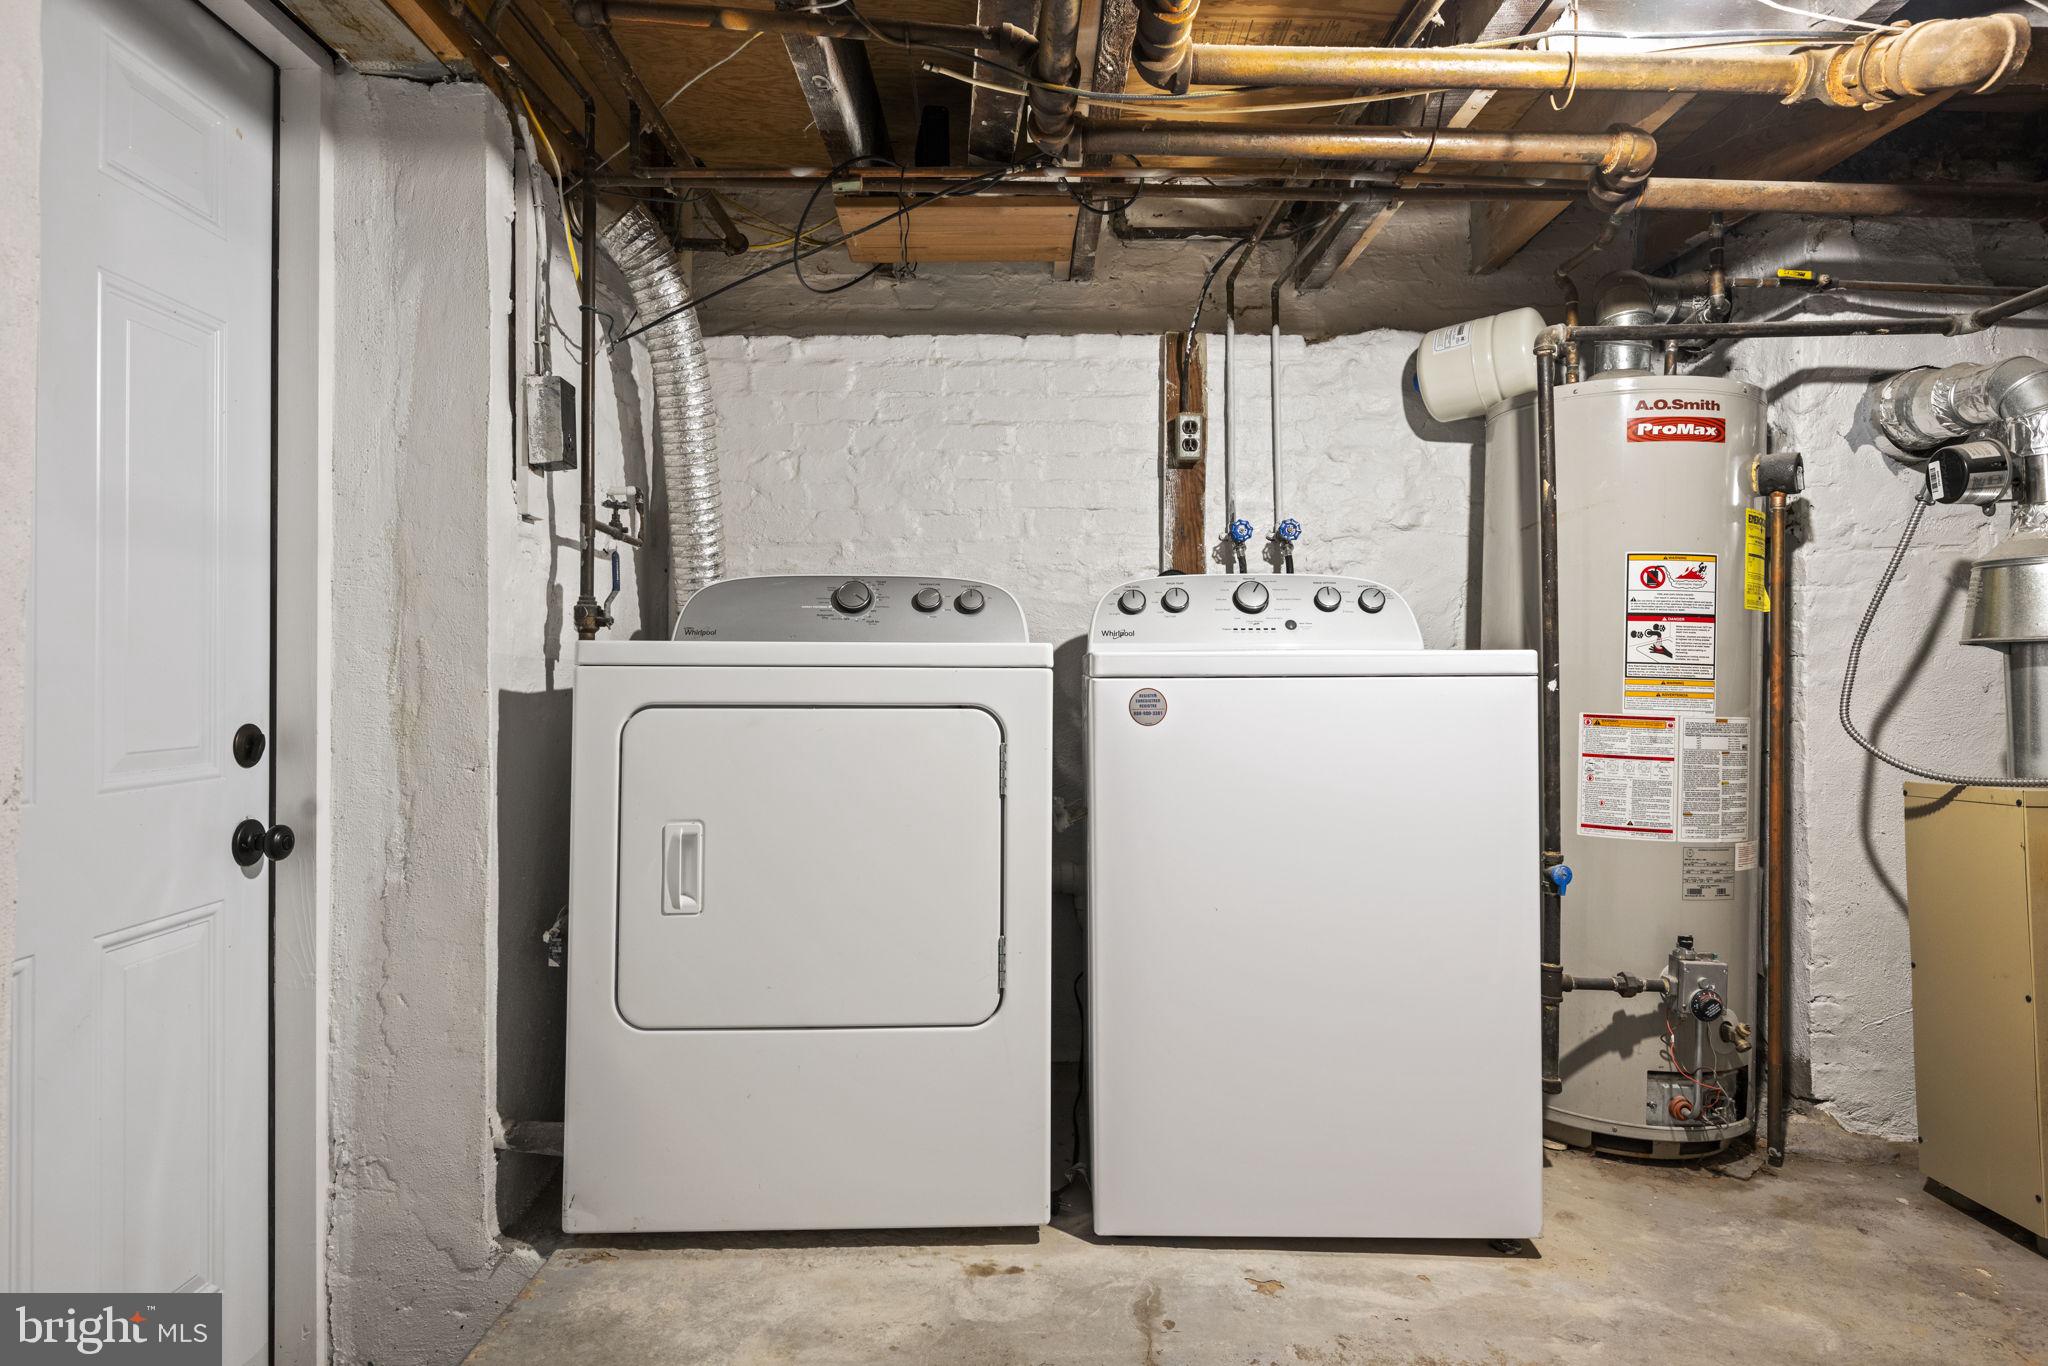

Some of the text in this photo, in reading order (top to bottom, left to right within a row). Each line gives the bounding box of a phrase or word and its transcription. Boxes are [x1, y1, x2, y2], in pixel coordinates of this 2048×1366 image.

[1635, 399, 1720, 411] A.O.Smith
[1637, 423, 1717, 436] ProMax
[684, 628, 717, 637] Whirlpool
[1101, 629, 1134, 639] Whirlpool
